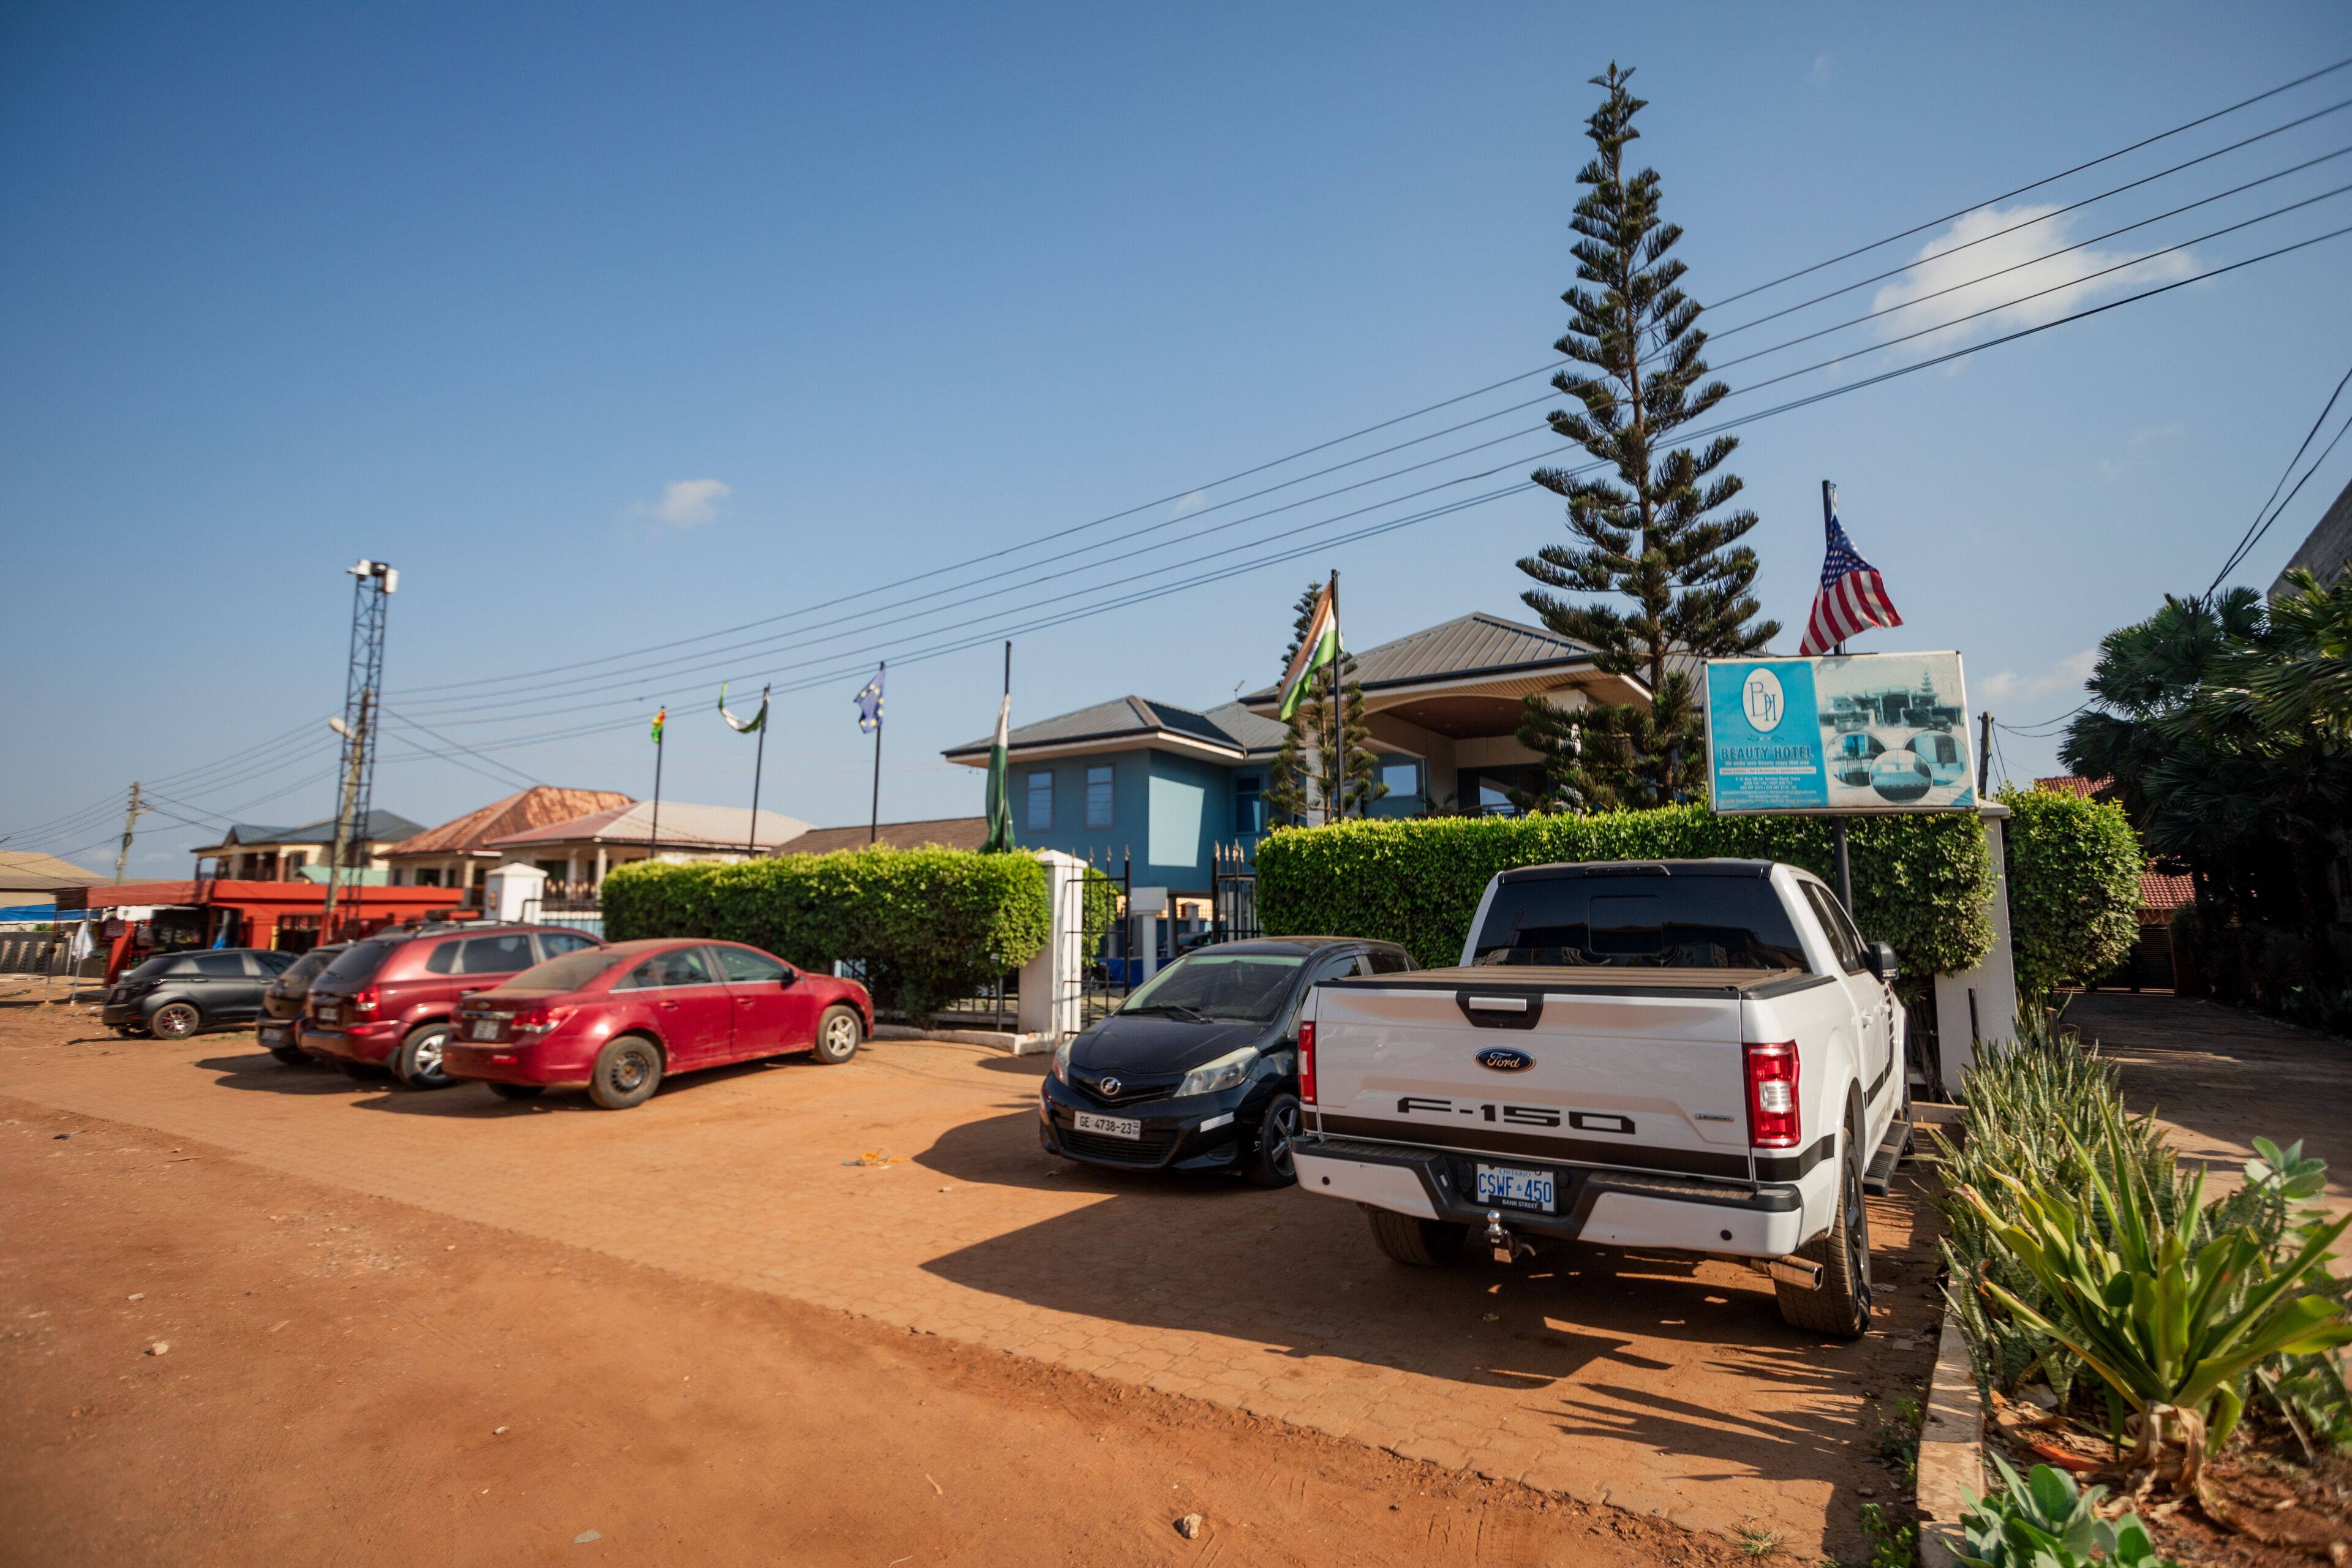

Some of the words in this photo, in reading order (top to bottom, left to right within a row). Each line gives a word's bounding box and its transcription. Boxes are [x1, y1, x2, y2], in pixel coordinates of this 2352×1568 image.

[1720, 745, 1770, 760] BEAUTY
[1773, 745, 1814, 759] HOTEL
[1487, 1052, 1520, 1068] Ford
[1397, 1096, 1636, 1134] F-150
[1080, 1116, 1090, 1128] GE
[1095, 1118, 1132, 1134] 4738-23
[1479, 1173, 1513, 1197] CSWF
[1525, 1179, 1552, 1202] 450
